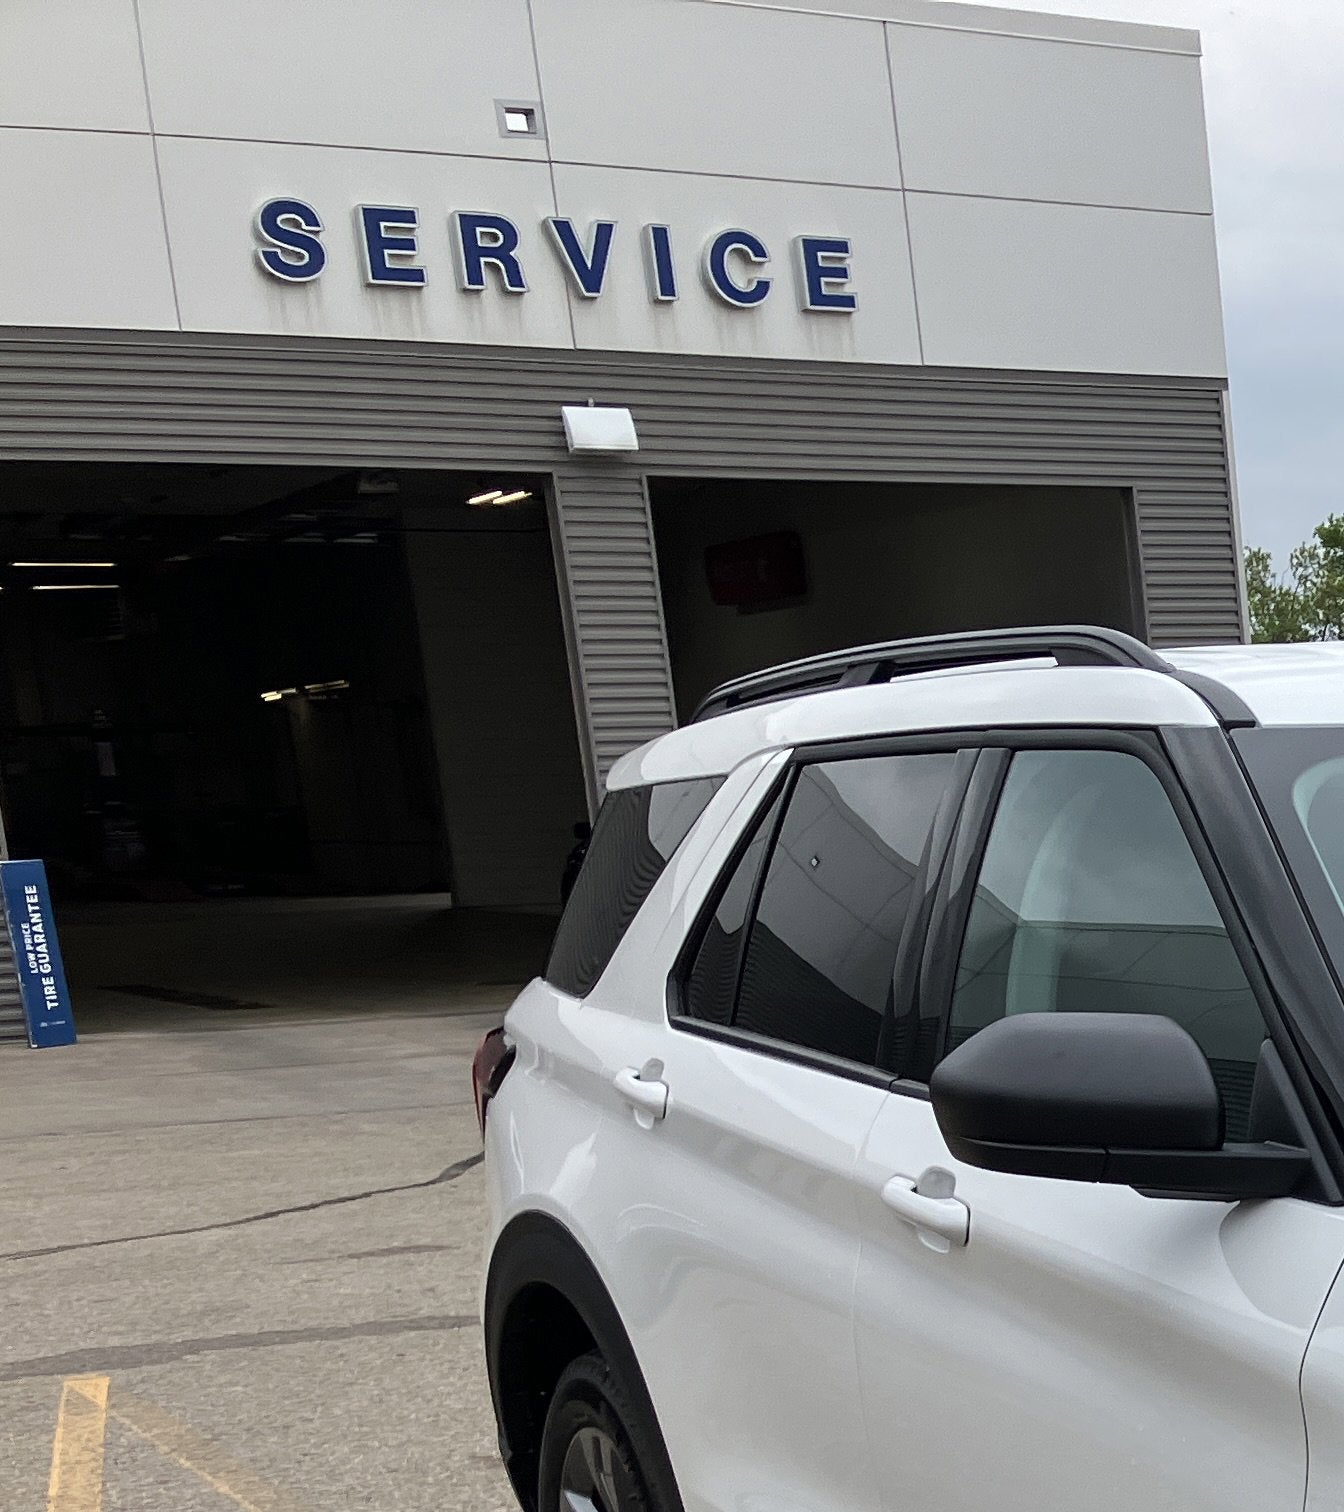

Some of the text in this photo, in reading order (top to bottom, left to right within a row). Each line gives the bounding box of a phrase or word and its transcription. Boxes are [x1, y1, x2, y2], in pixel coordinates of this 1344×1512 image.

[254, 197, 858, 313] SERVICE
[21, 922, 39, 974] LOW PRICE
[25, 884, 52, 974] GUARANTEE
[42, 975, 59, 1011] TIRE
